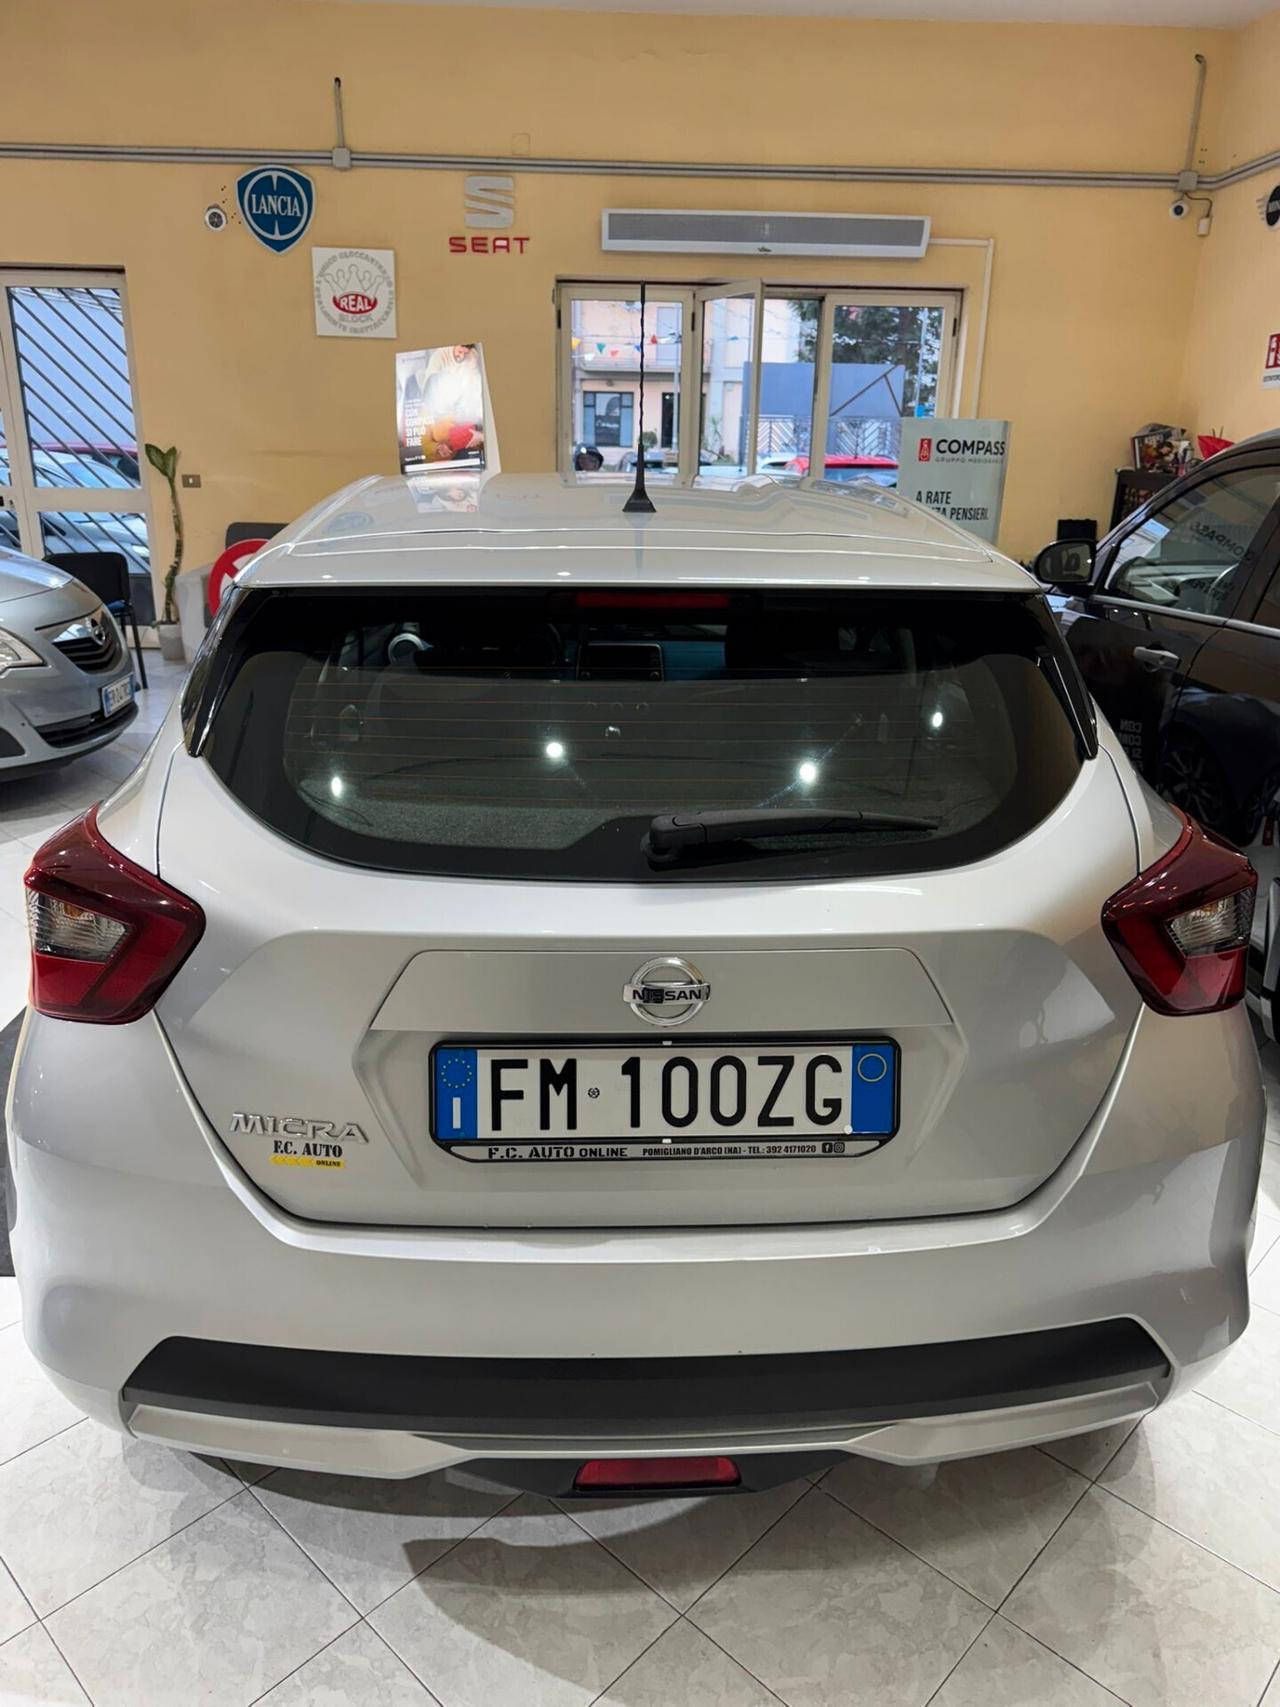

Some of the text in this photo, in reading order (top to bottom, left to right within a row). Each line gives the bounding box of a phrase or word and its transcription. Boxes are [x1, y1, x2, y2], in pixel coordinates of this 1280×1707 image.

[251, 194, 301, 217] LANCIA
[449, 236, 530, 254] SEAT
[339, 295, 373, 312] REAL
[936, 439, 1006, 456] COMPASS
[916, 490, 952, 505] A RATE
[491, 1055, 842, 1131] FM 100ZG
[230, 1112, 369, 1143] MICRA
[273, 1140, 343, 1158] F.C. AUTO
[488, 1147, 523, 1159] F.C.
[528, 1146, 575, 1159] AUTO
[579, 1147, 628, 1158] ONLINE
[643, 1147, 692, 1156] POMIGLIANO
[694, 1146, 723, 1155] D'ARCO
[766, 1146, 782, 1154] 392
[783, 1145, 816, 1154] 4171020
[316, 1159, 341, 1168] ONLINE
